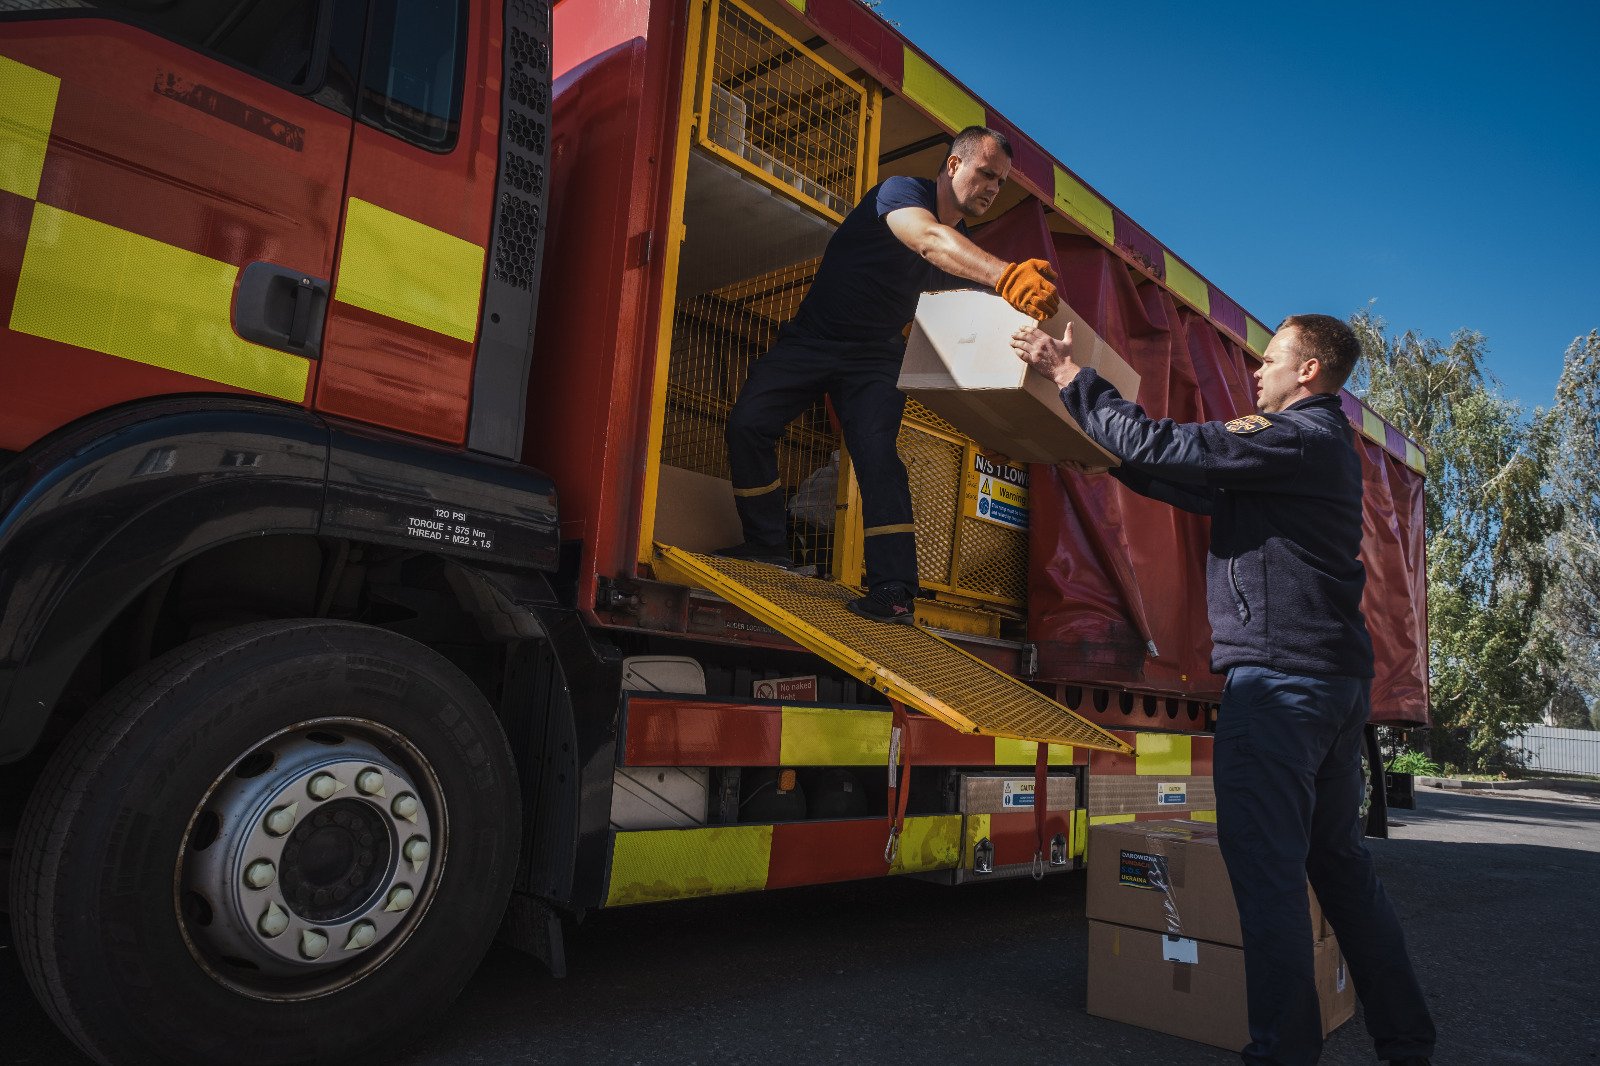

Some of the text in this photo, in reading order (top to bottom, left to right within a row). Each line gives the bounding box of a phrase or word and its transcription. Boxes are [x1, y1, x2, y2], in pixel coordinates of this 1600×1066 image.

[976, 455, 994, 474] N/S
[1000, 487, 1026, 506] Warning
[435, 509, 466, 521] 120 PSI
[409, 518, 444, 530] TORQUE
[455, 526, 470, 535] 575
[472, 529, 486, 538] Nm
[408, 527, 442, 540] THREAD
[452, 535, 469, 544] M22
[480, 540, 491, 548] 1.5
[792, 681, 812, 690] naked
[1122, 852, 1157, 862] DAROWIZNA
[1122, 875, 1147, 883] UKRAINA
